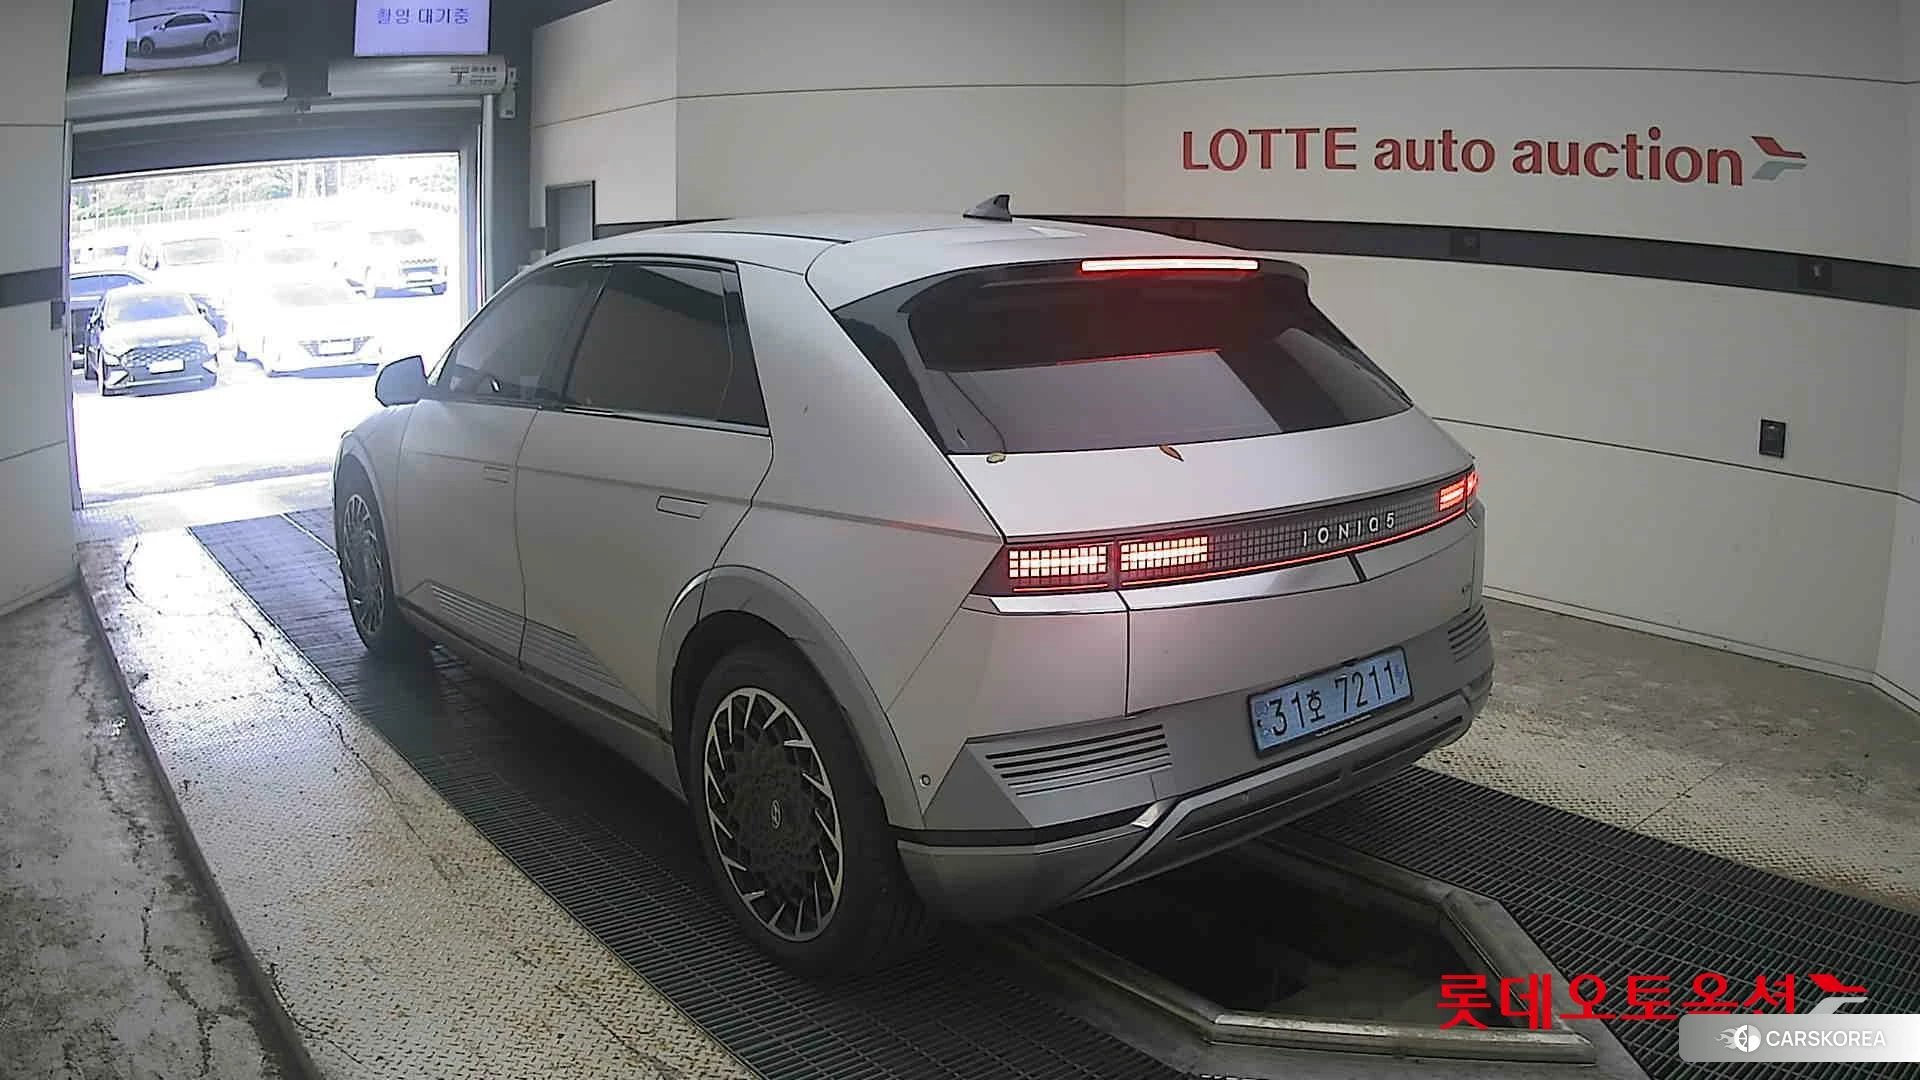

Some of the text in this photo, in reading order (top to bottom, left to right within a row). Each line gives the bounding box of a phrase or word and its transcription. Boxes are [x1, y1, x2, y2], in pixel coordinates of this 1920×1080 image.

[418, 8, 469, 25] 대기중
[1182, 126, 1744, 186] LOTTE auto auction
[1268, 660, 1396, 736] 31호 7211
